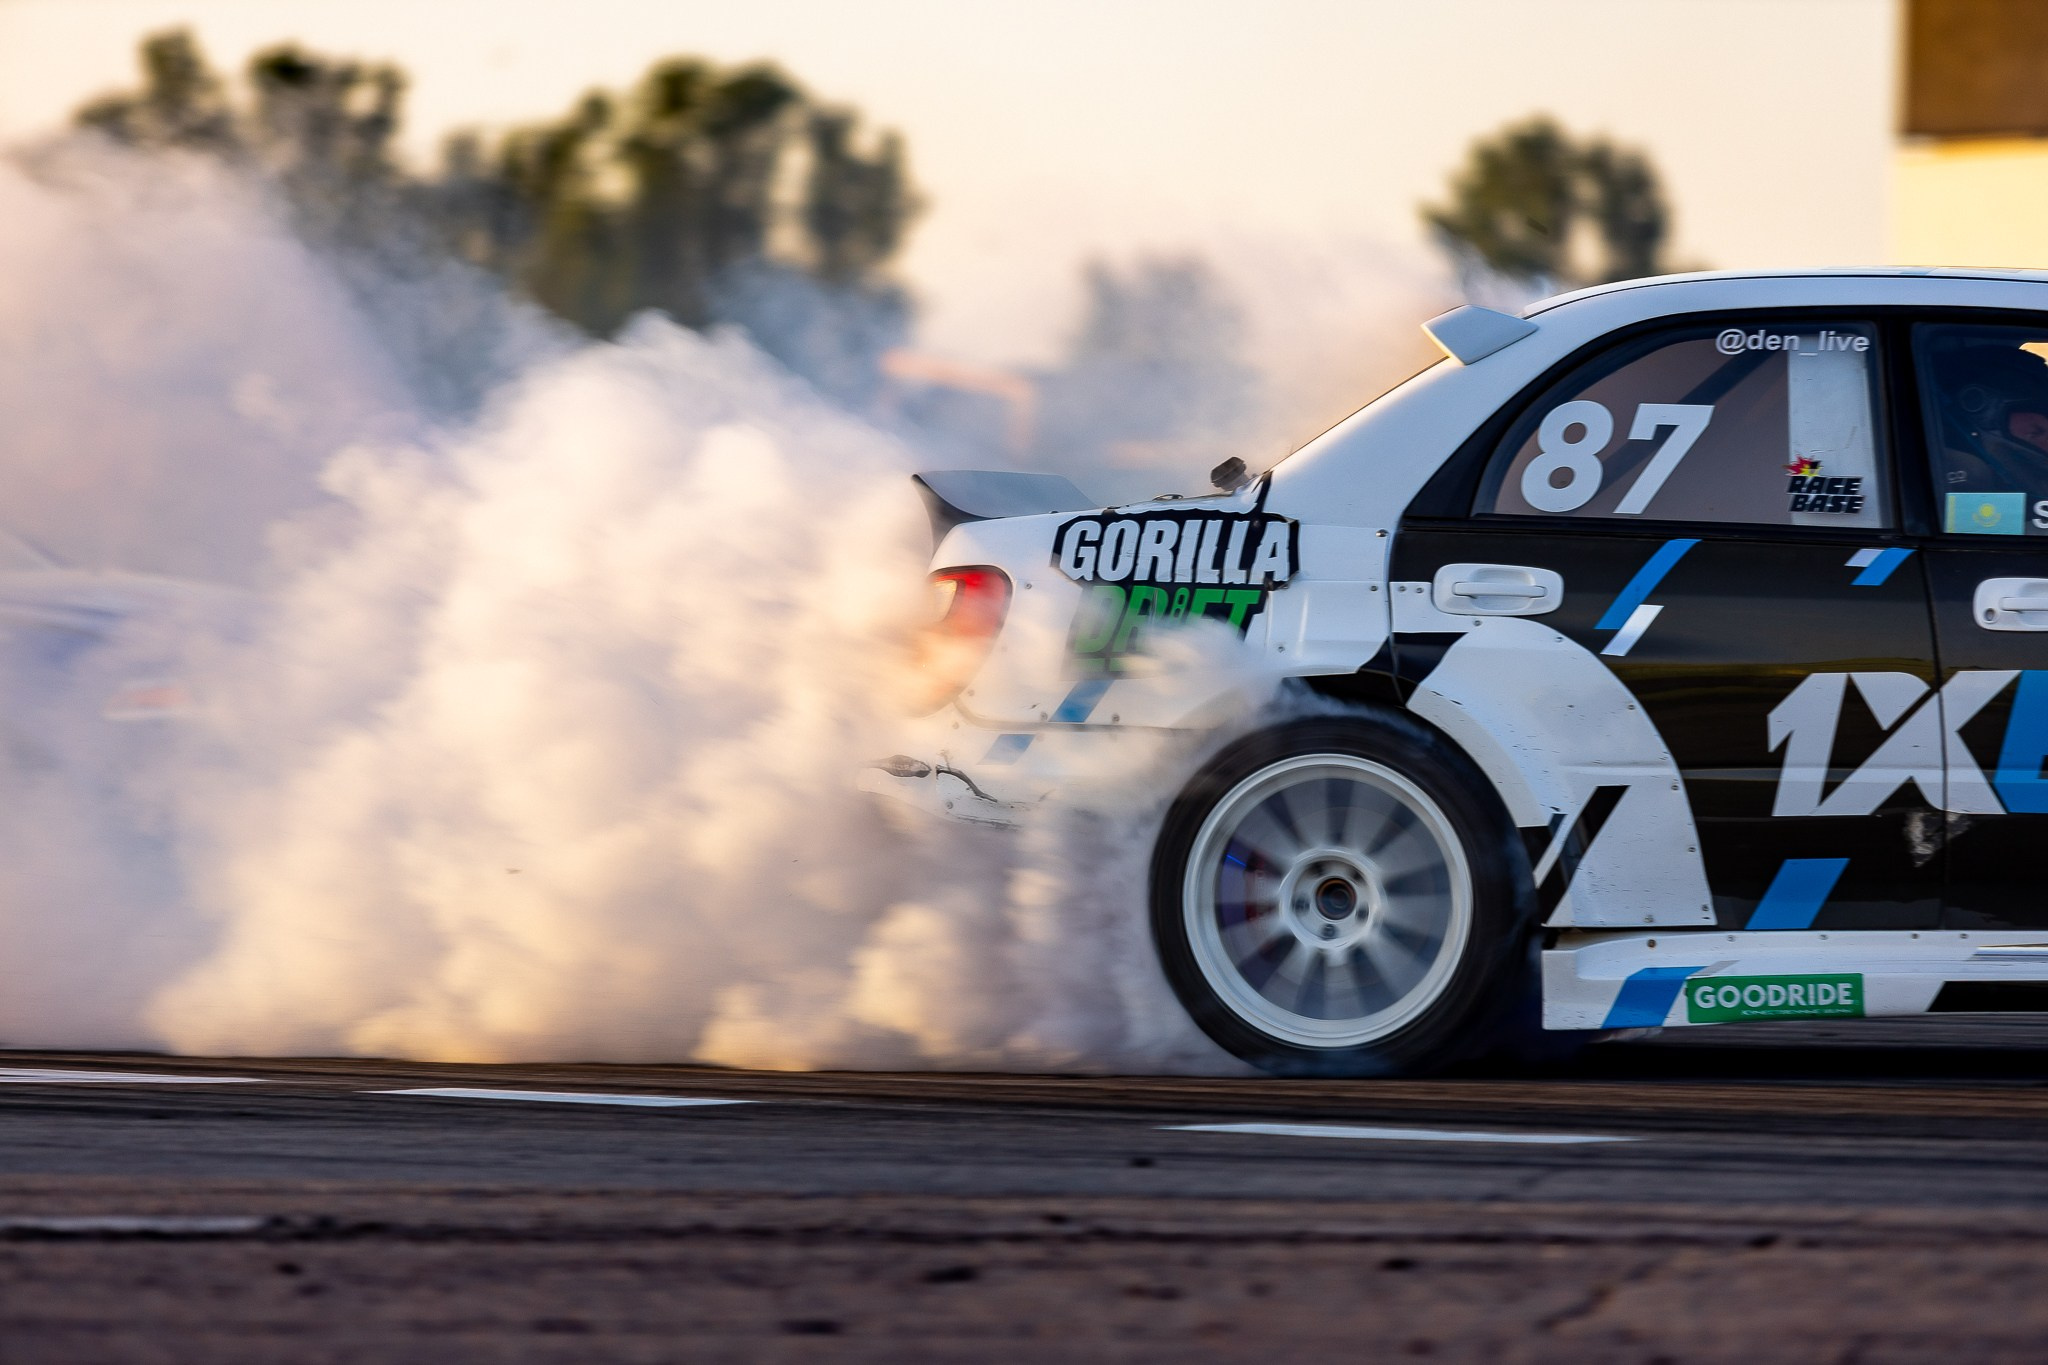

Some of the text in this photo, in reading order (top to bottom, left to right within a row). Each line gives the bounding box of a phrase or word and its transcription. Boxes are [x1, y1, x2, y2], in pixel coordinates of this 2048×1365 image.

[1715, 328, 1871, 355] @den_live
[1520, 400, 1715, 515] 87
[1787, 475, 1863, 495] RACE
[1790, 494, 1865, 514] BASE
[1059, 519, 1291, 585] GORILLA
[1694, 982, 1855, 1009] GOODRIDE
